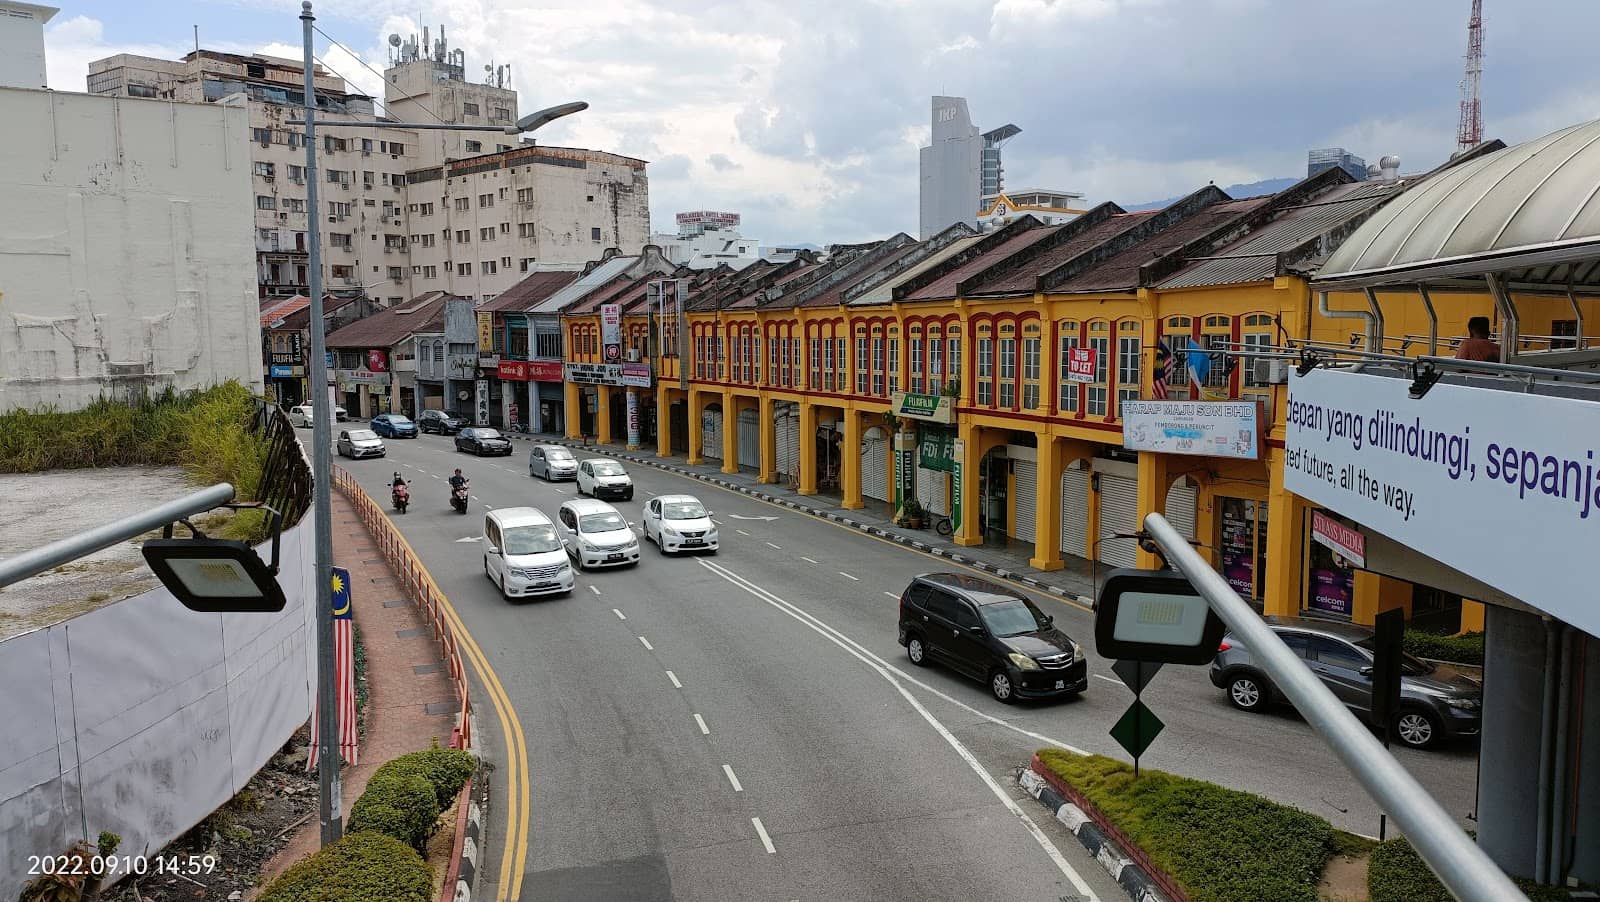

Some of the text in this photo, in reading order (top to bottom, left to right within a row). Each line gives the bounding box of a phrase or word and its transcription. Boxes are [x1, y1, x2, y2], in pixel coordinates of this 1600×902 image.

[1070, 360, 1093, 374] TO LET
[908, 396, 933, 408] FUJIFILM
[1123, 403, 1162, 415] HARAP
[1163, 404, 1195, 416] MAJU
[1224, 405, 1254, 418] BHD
[922, 442, 938, 459] FDi
[1326, 408, 1363, 451] yang
[1369, 409, 1476, 482] dilindungi,
[1303, 449, 1336, 489] future,
[1340, 463, 1354, 491] all
[1358, 468, 1379, 501] the
[1383, 482, 1415, 521] way.
[1339, 528, 1363, 555] MEDIA
[1315, 595, 1345, 607] celcom
